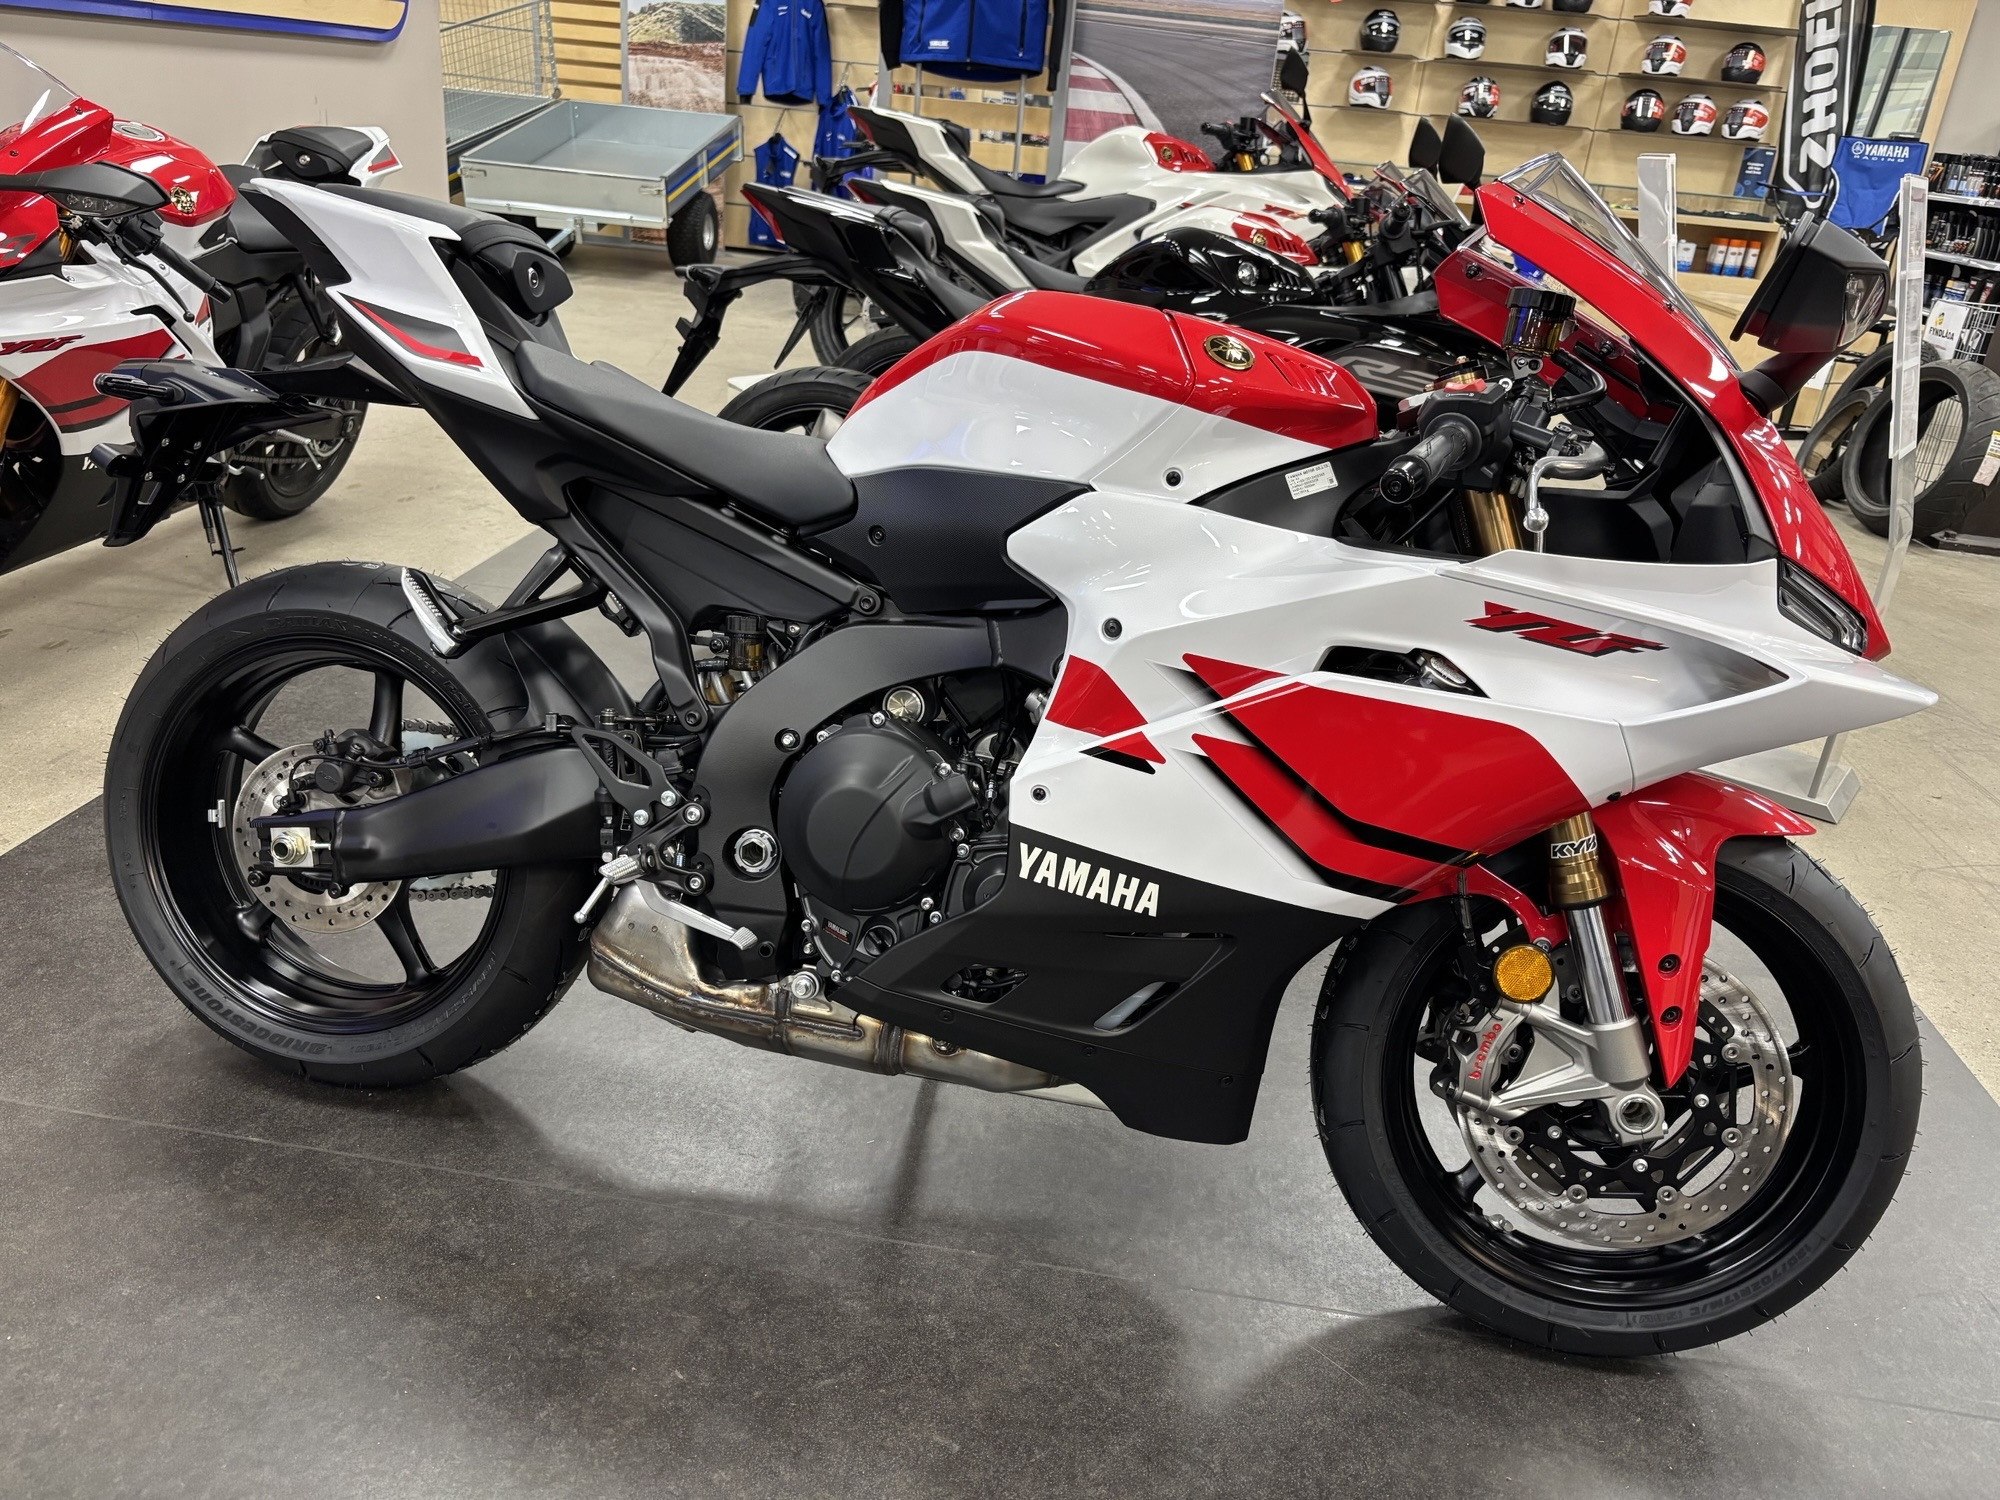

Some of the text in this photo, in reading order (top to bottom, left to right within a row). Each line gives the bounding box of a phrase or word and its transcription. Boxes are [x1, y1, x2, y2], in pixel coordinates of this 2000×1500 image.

[1854, 155, 1905, 163] RACING
[1865, 144, 1910, 159] YAMAHA
[1463, 600, 1670, 658] YZF
[1019, 842, 1160, 918] YAMAHA
[182, 977, 327, 1055] BRIDGESTONE
[1467, 1023, 1502, 1080] brembo
